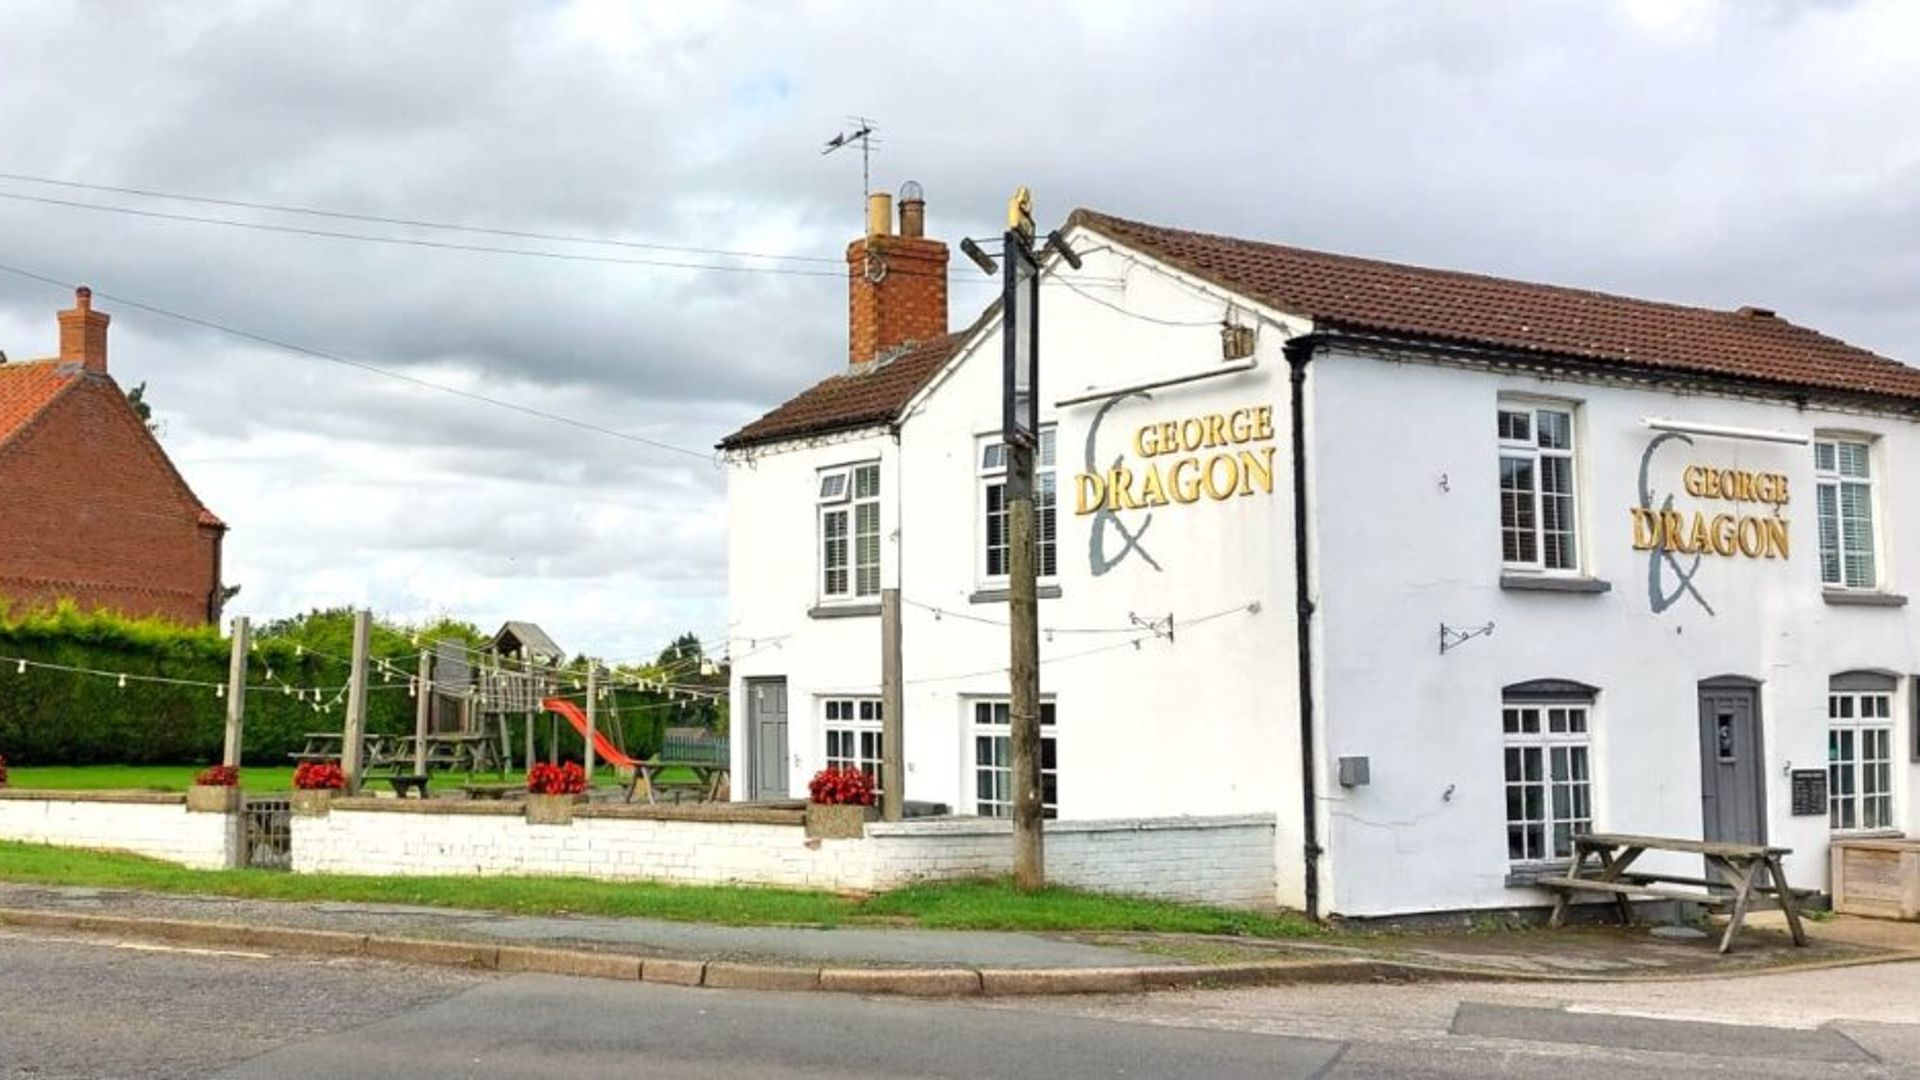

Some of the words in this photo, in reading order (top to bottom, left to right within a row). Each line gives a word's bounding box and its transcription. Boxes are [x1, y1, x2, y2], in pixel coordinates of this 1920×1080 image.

[1134, 405, 1275, 458] GEORGE
[1074, 446, 1277, 516] DRAGON
[1683, 464, 1790, 505] GEORGE
[1630, 507, 1790, 561] DRAGON
